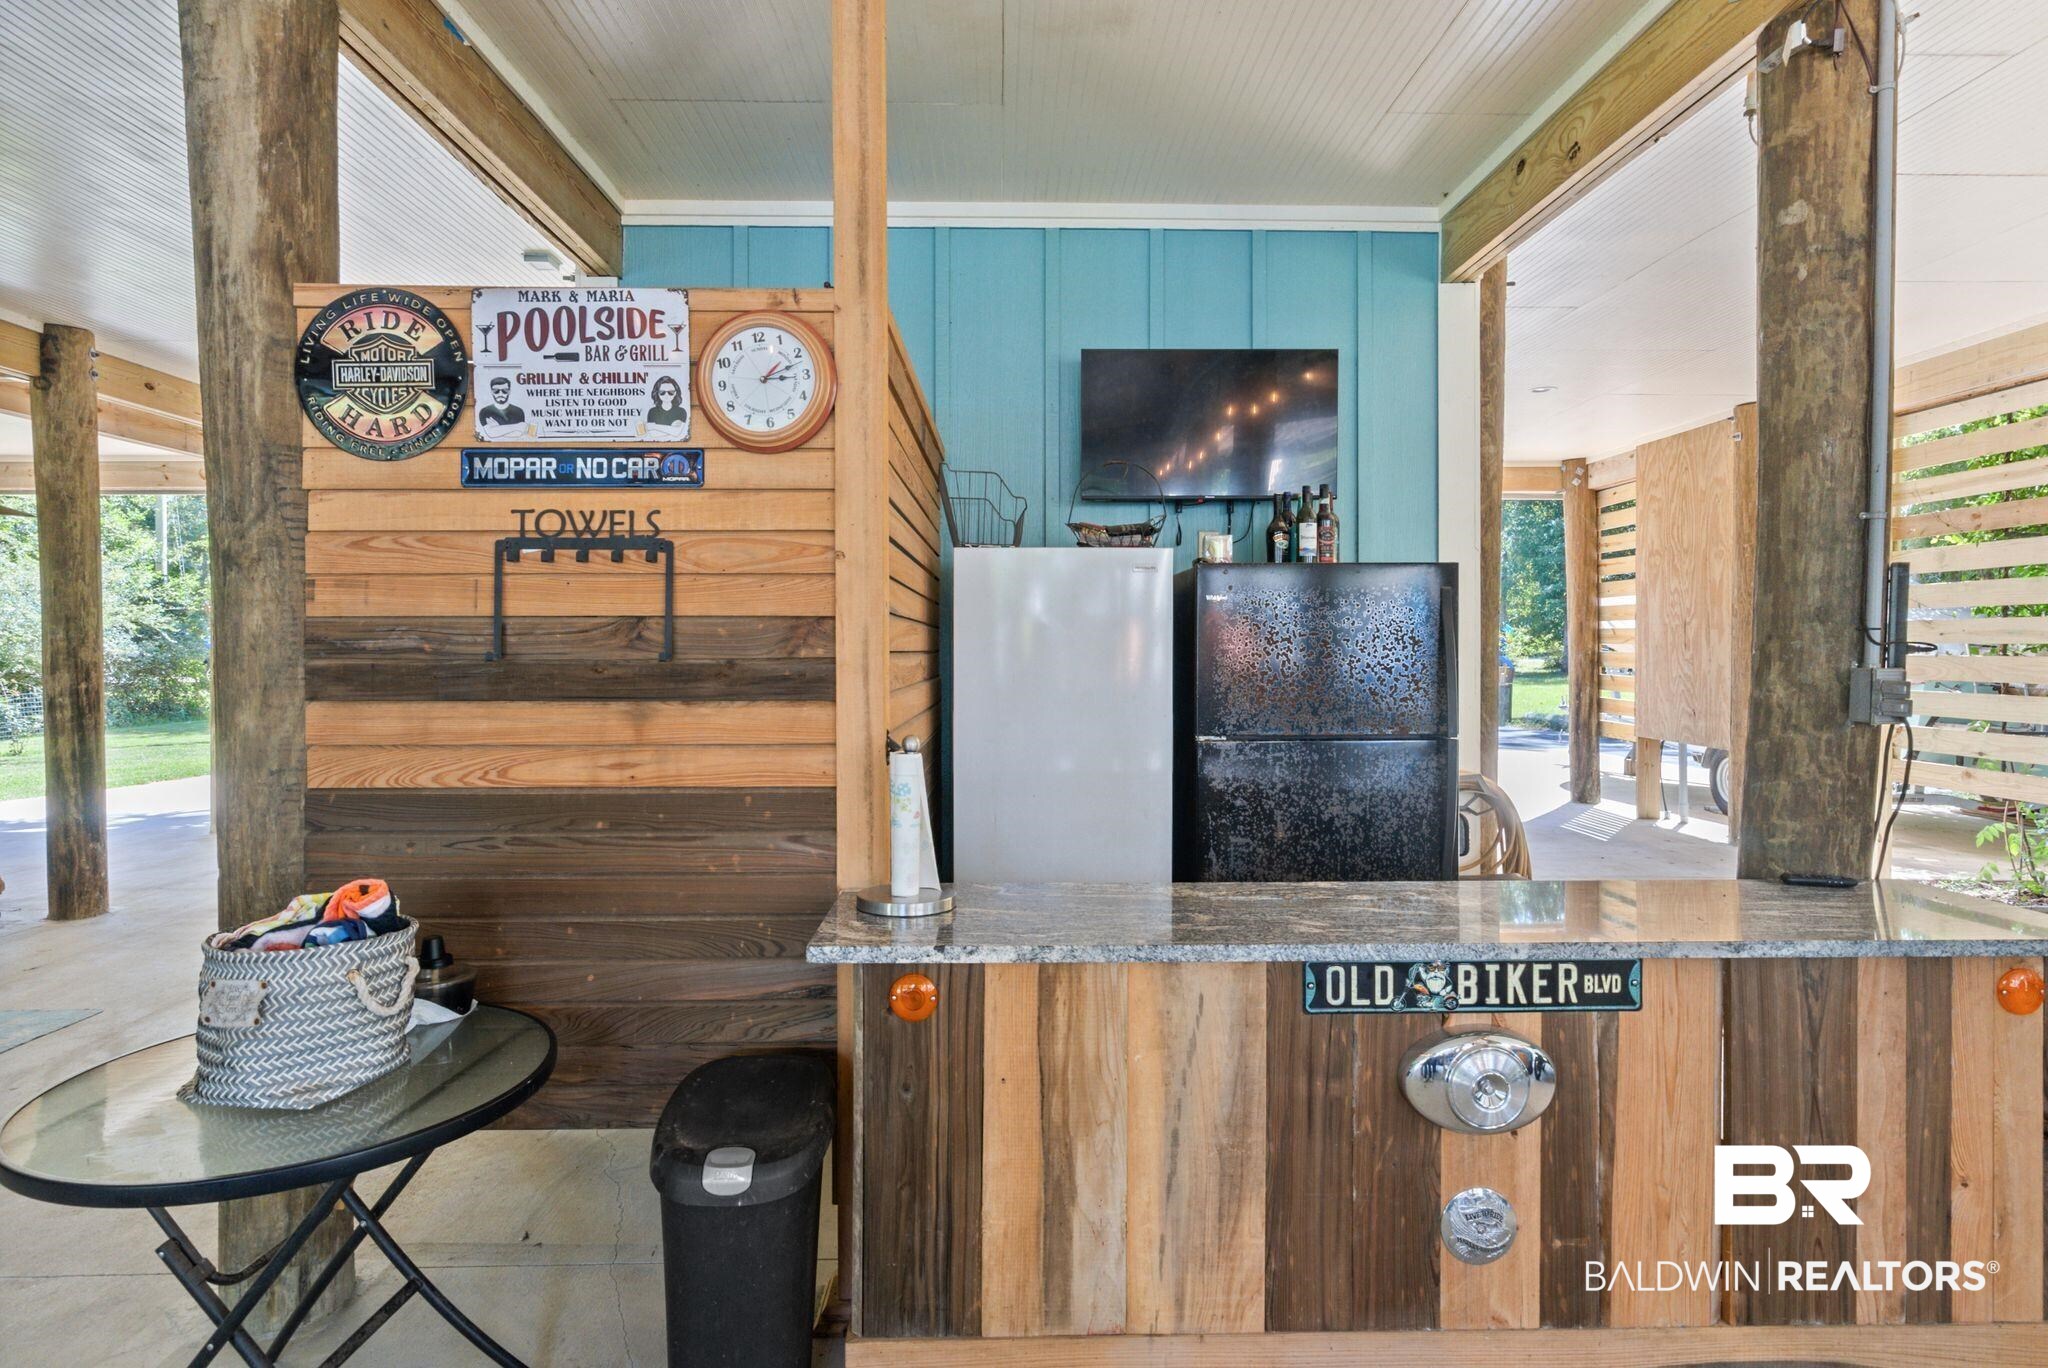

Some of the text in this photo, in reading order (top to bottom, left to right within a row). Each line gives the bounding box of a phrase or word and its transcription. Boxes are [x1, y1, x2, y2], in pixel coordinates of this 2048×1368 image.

[517, 289, 635, 303] MARK & MARIA
[300, 291, 465, 364] LIVING LIFE WIDE OPEN
[338, 309, 427, 343] RIDE
[496, 305, 667, 362] POOLSIDE
[751, 331, 766, 343] 12
[776, 334, 783, 345] 1
[731, 340, 743, 352] 11
[360, 344, 407, 362] MOTOR
[584, 345, 610, 362] BAR
[629, 344, 669, 362] GRILL
[793, 347, 802, 359] 2
[716, 357, 731, 369] 10
[340, 366, 428, 382] HARLEY-DAVIDSON
[515, 371, 649, 385] GRILLIN' & CHILLIN'
[801, 368, 811, 380] 3
[718, 380, 727, 392] 9
[362, 387, 408, 408] CYCLES
[526, 388, 646, 397] WHERE THE NEIGHBORS
[799, 390, 807, 401] 4
[545, 398, 628, 407] LISTEN TO GOOD
[726, 400, 735, 412] 8
[307, 396, 345, 443] RIDING
[441, 393, 463, 427] 1903
[531, 408, 643, 417] MUSIC WHETHER THEY
[787, 408, 795, 420] 5
[338, 402, 434, 438] HARD
[545, 418, 629, 427] WANT TO OR NOT
[744, 414, 752, 425] 7
[766, 417, 775, 428] 6
[472, 457, 661, 480] MOPAR OR NO CAR
[510, 508, 662, 539] TOWELS
[1325, 963, 1623, 1007] OLD BIKER BLVD
